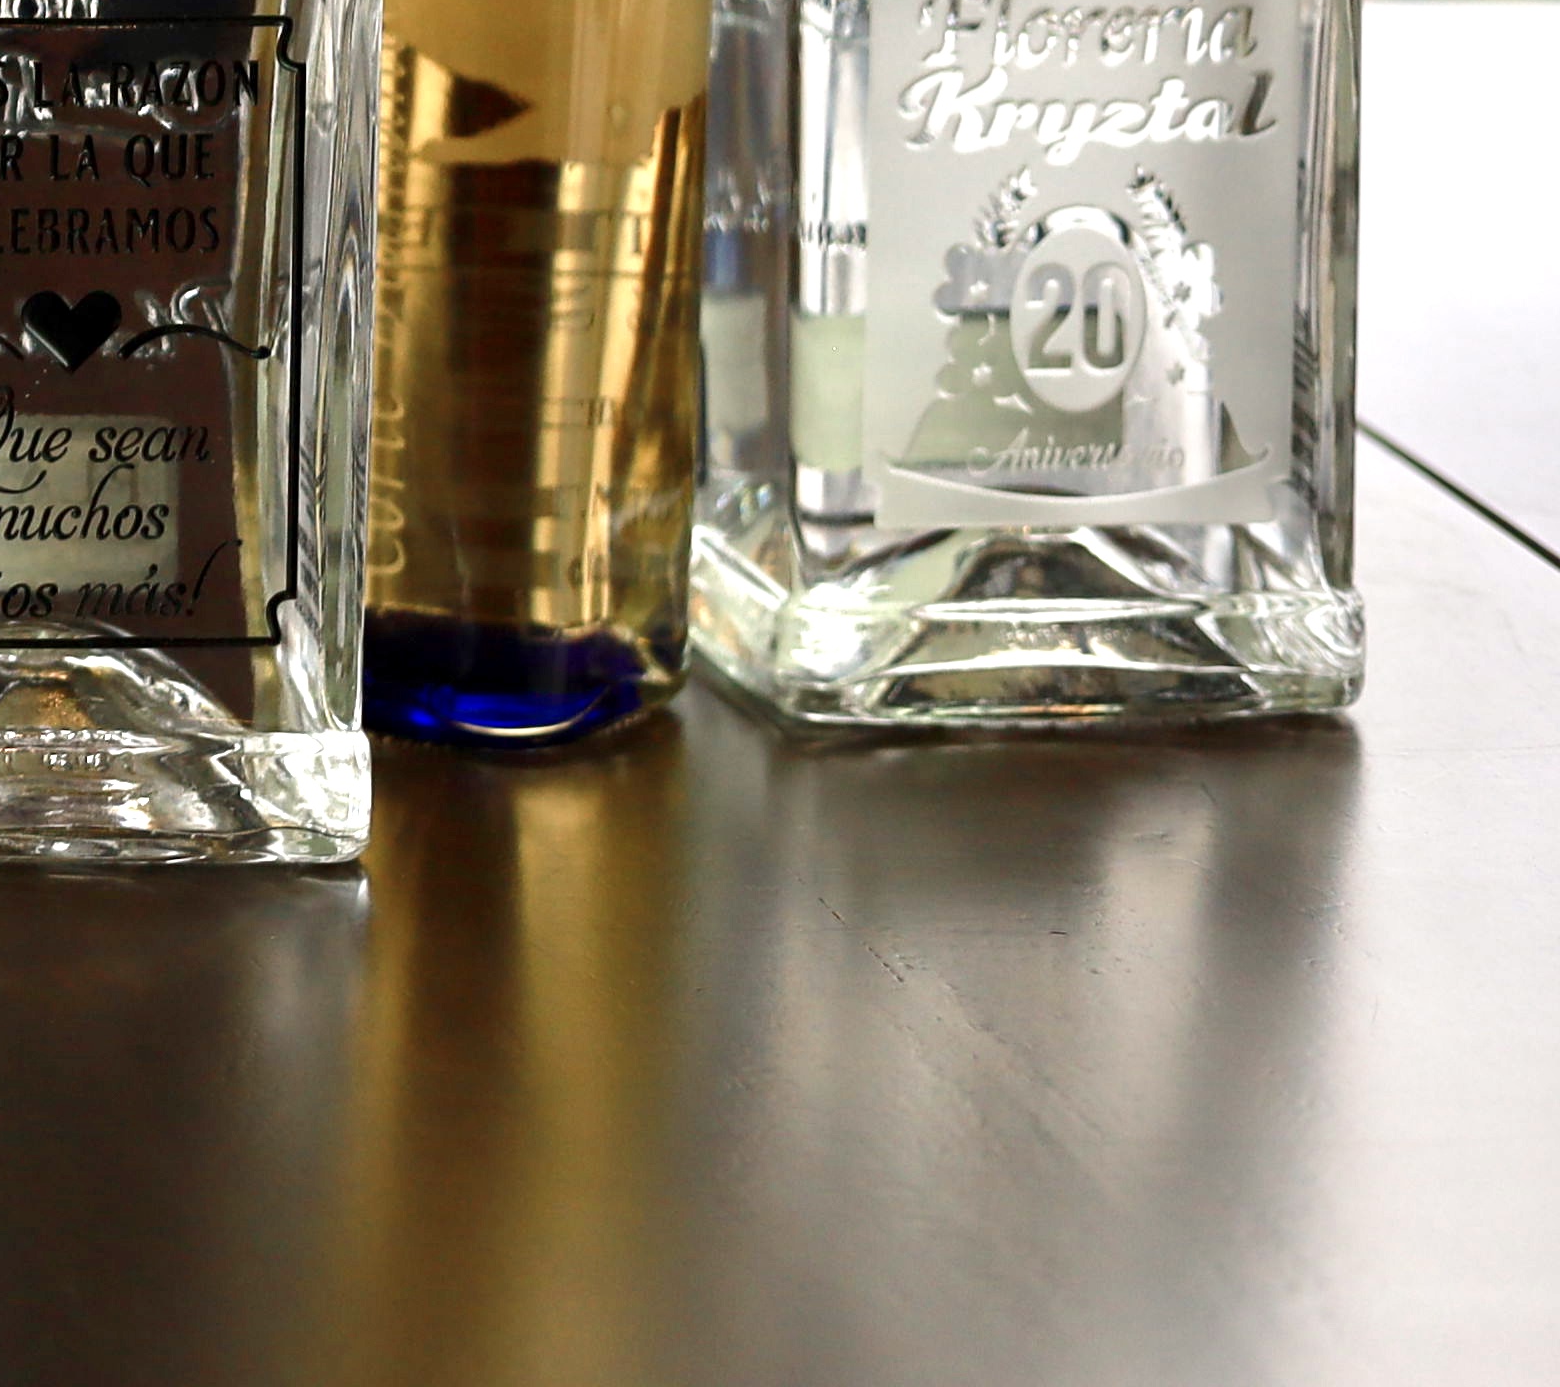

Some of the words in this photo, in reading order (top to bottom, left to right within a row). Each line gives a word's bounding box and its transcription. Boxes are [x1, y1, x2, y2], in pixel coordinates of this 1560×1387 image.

[897, 67, 1281, 167] Kryztal
[49, 132, 102, 183] LA
[124, 131, 216, 188] QUE
[1022, 260, 1128, 378] 20
[87, 424, 213, 465] sean
[966, 426, 1187, 477] Aniversario
[75, 537, 246, 619] más!
